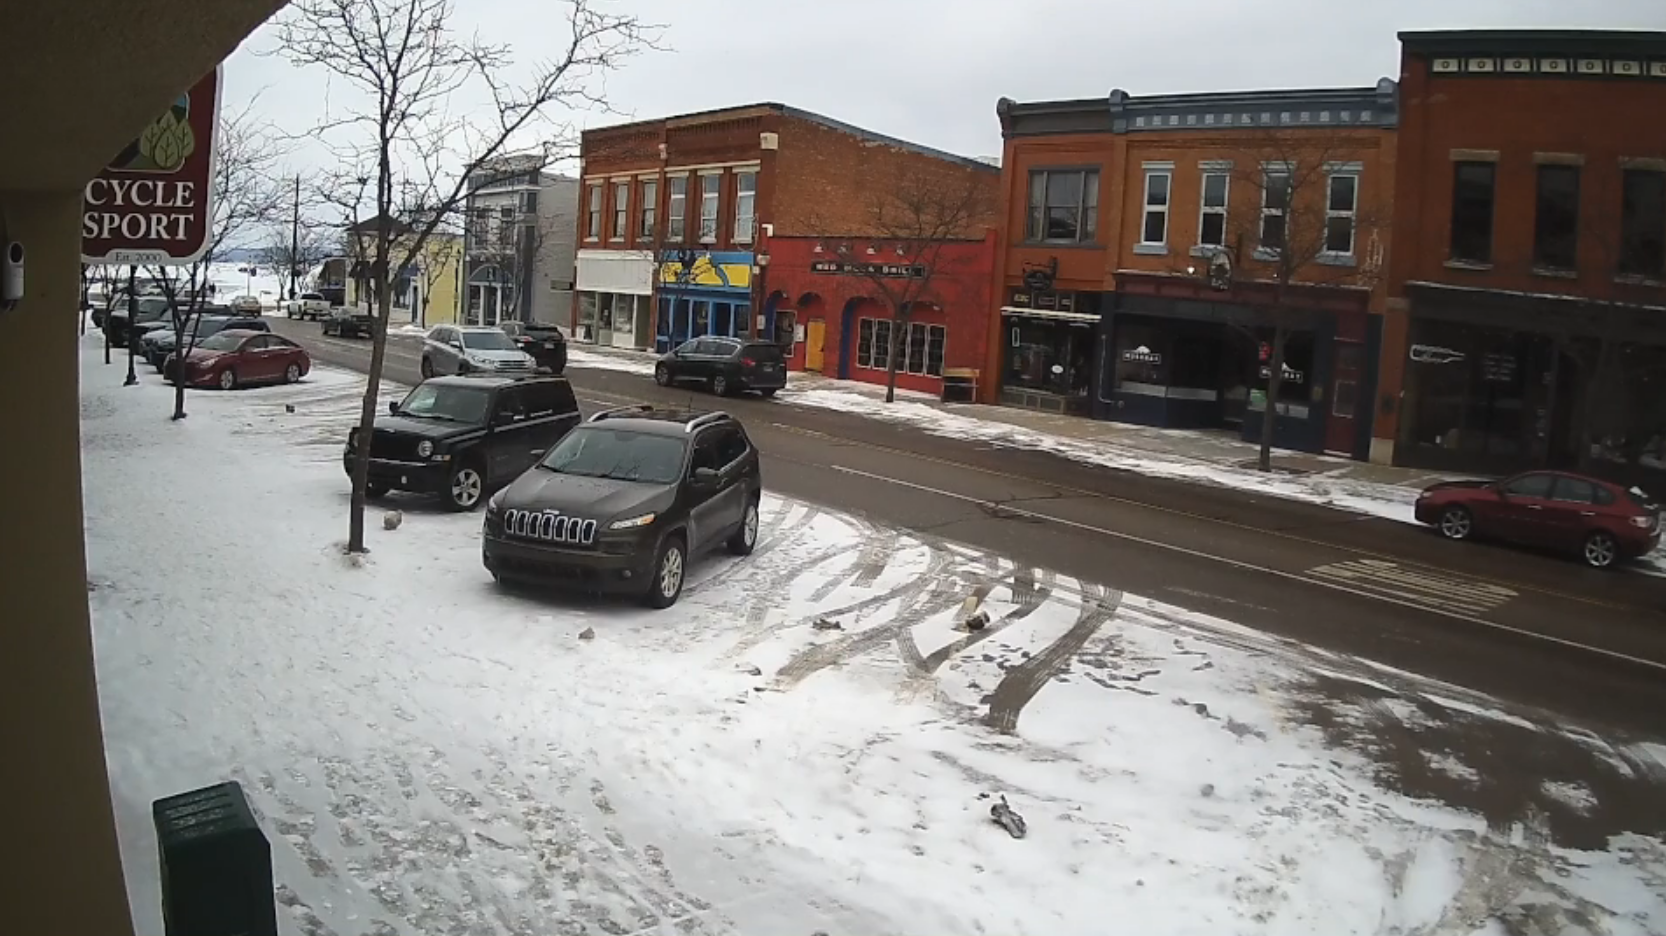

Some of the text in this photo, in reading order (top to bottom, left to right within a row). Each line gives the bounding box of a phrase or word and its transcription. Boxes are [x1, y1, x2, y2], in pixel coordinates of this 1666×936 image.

[84, 178, 194, 207] CYCLE
[82, 212, 194, 240] SPORT
[115, 252, 162, 263] Est. 2000
